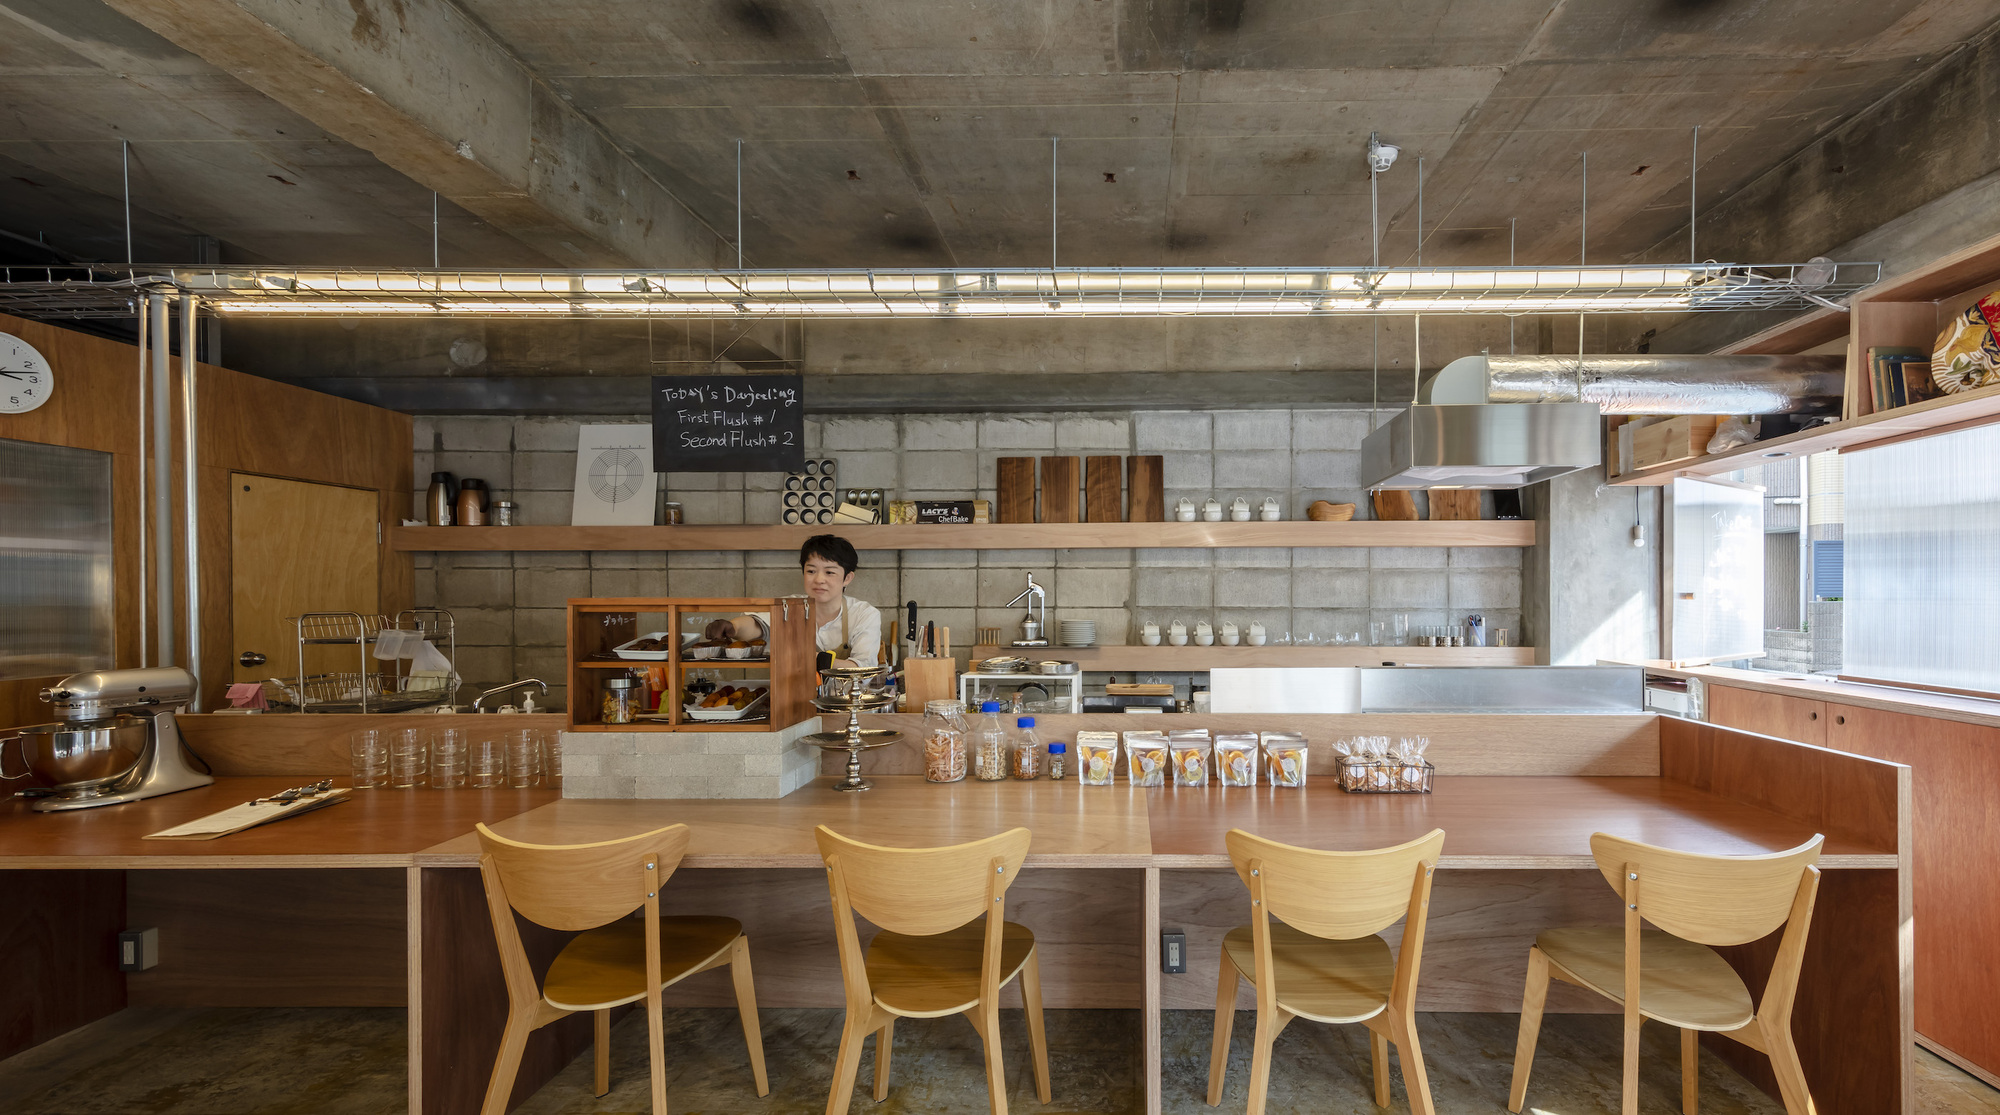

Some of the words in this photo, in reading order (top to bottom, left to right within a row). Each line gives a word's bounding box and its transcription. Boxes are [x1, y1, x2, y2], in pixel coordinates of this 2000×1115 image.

[24, 361, 33, 369] 2
[29, 375, 38, 384] 3
[10, 396, 19, 404] 5
[724, 385, 797, 407] Darjeeling
[677, 408, 710, 425] First
[712, 410, 749, 427] Flush
[680, 430, 727, 448] Second
[730, 430, 767, 448] Flush
[782, 430, 795, 446] 2
[939, 515, 968, 523] ChefBake
